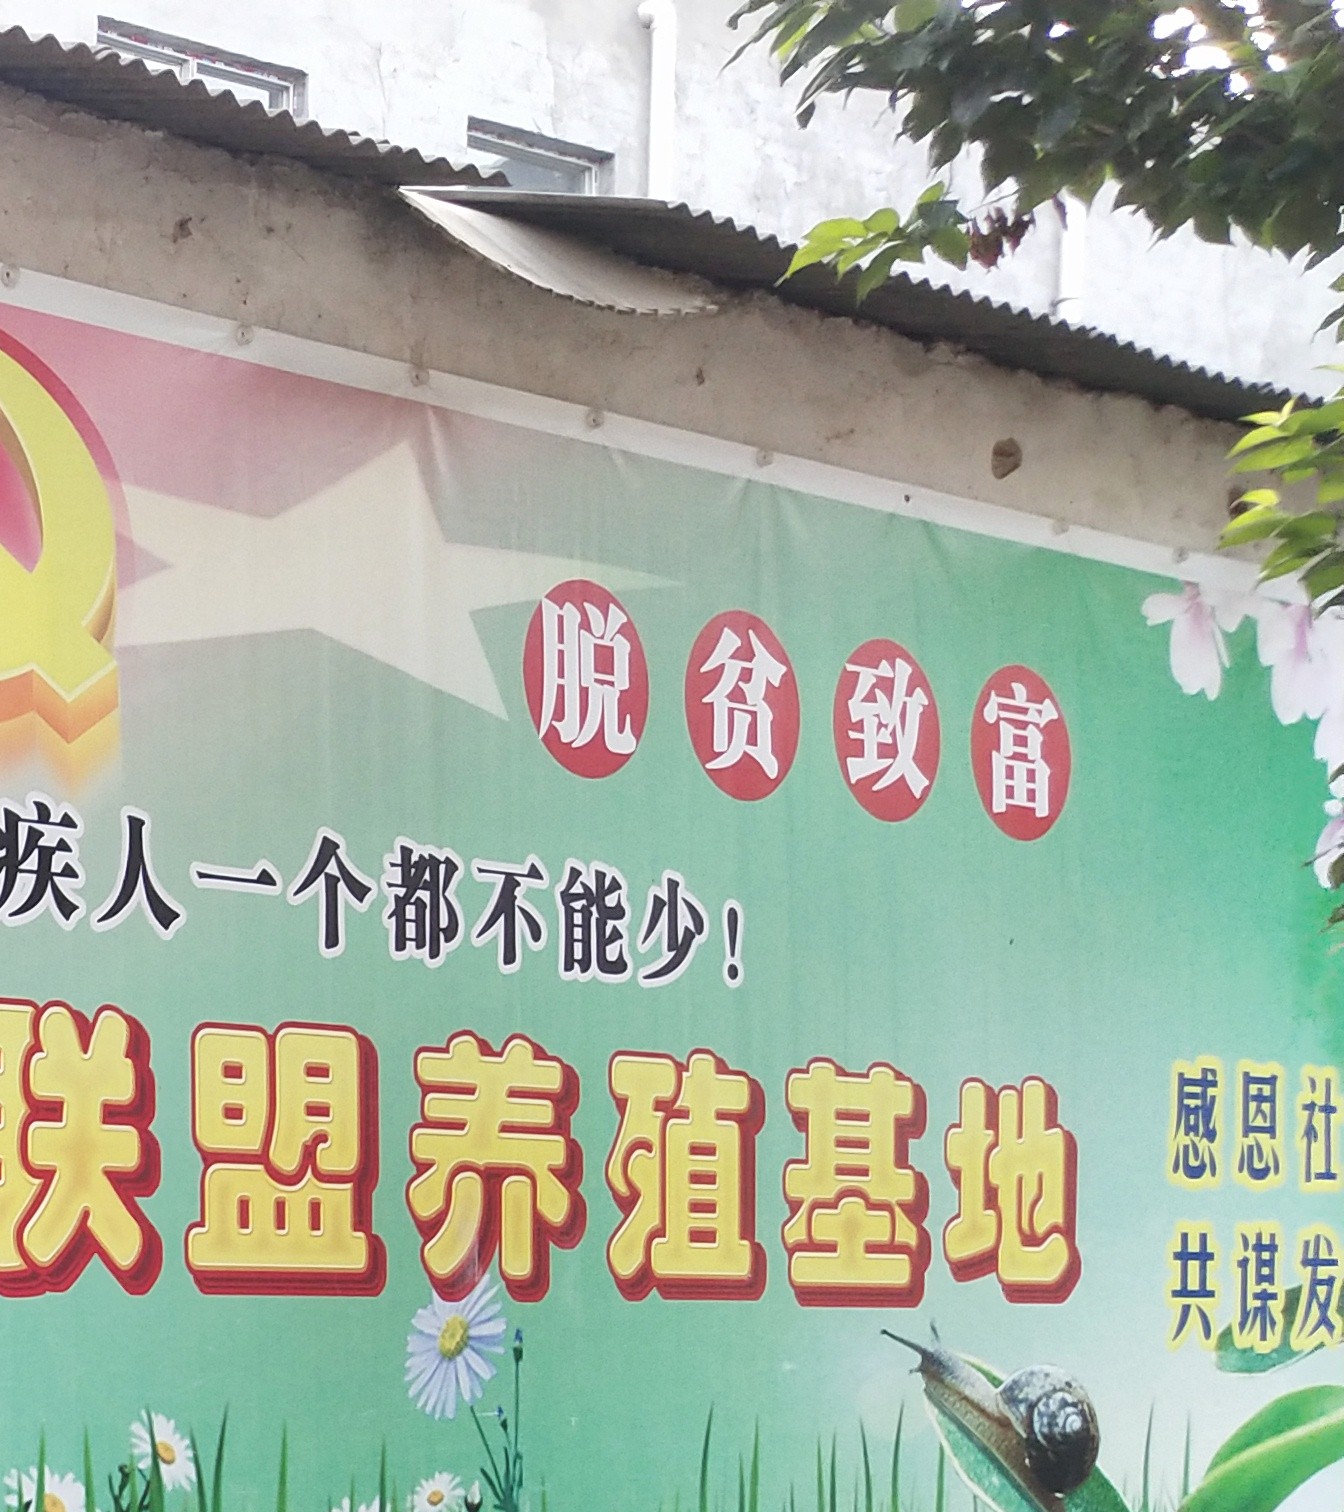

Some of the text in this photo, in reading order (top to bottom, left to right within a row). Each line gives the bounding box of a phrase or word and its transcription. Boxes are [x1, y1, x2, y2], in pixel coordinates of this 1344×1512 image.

[538, 598, 1064, 818] 脱贫致富
[1171, 1066, 1338, 1183] 感恩社
[1170, 1230, 1339, 1342] 共谋发
